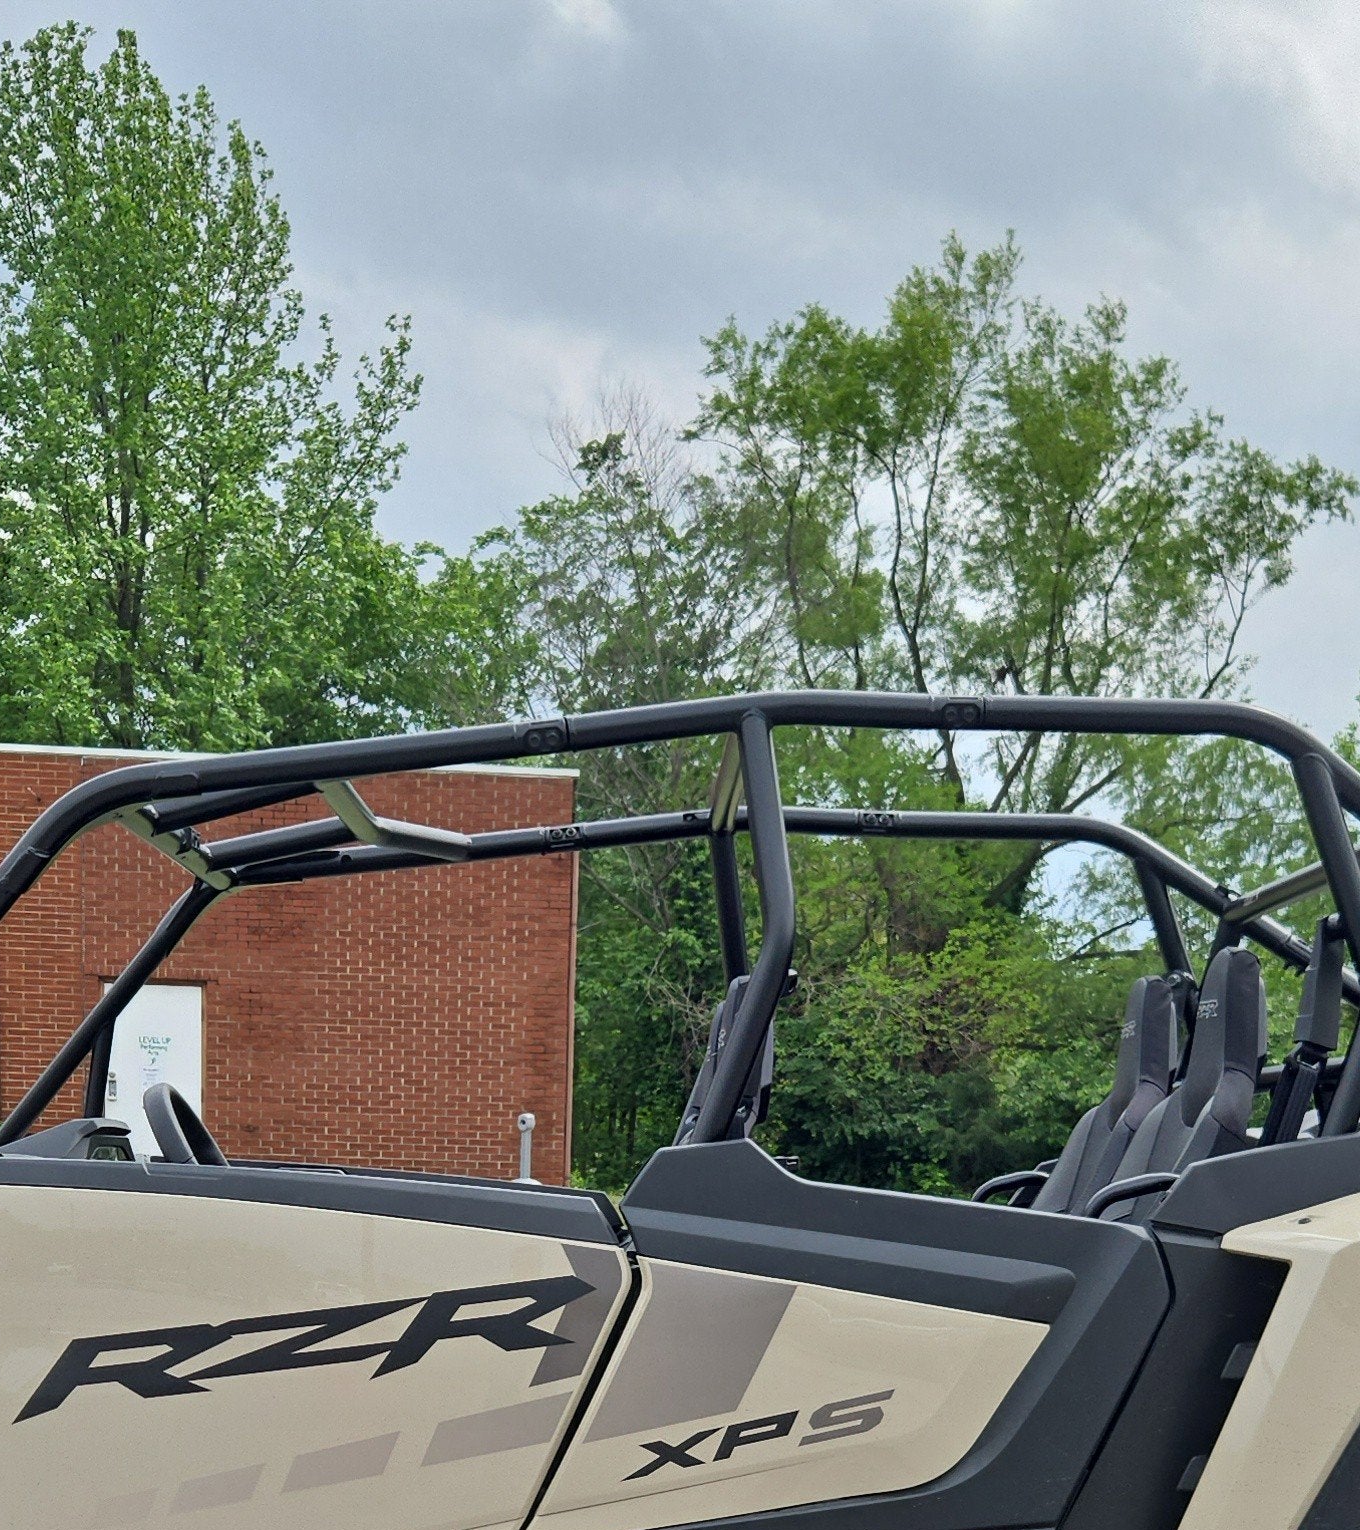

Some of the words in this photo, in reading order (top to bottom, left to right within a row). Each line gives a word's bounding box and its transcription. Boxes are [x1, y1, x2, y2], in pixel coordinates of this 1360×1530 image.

[139, 1036, 160, 1044] LEVEL
[11, 1275, 597, 1425] RZR
[620, 1389, 895, 1482] XPS
